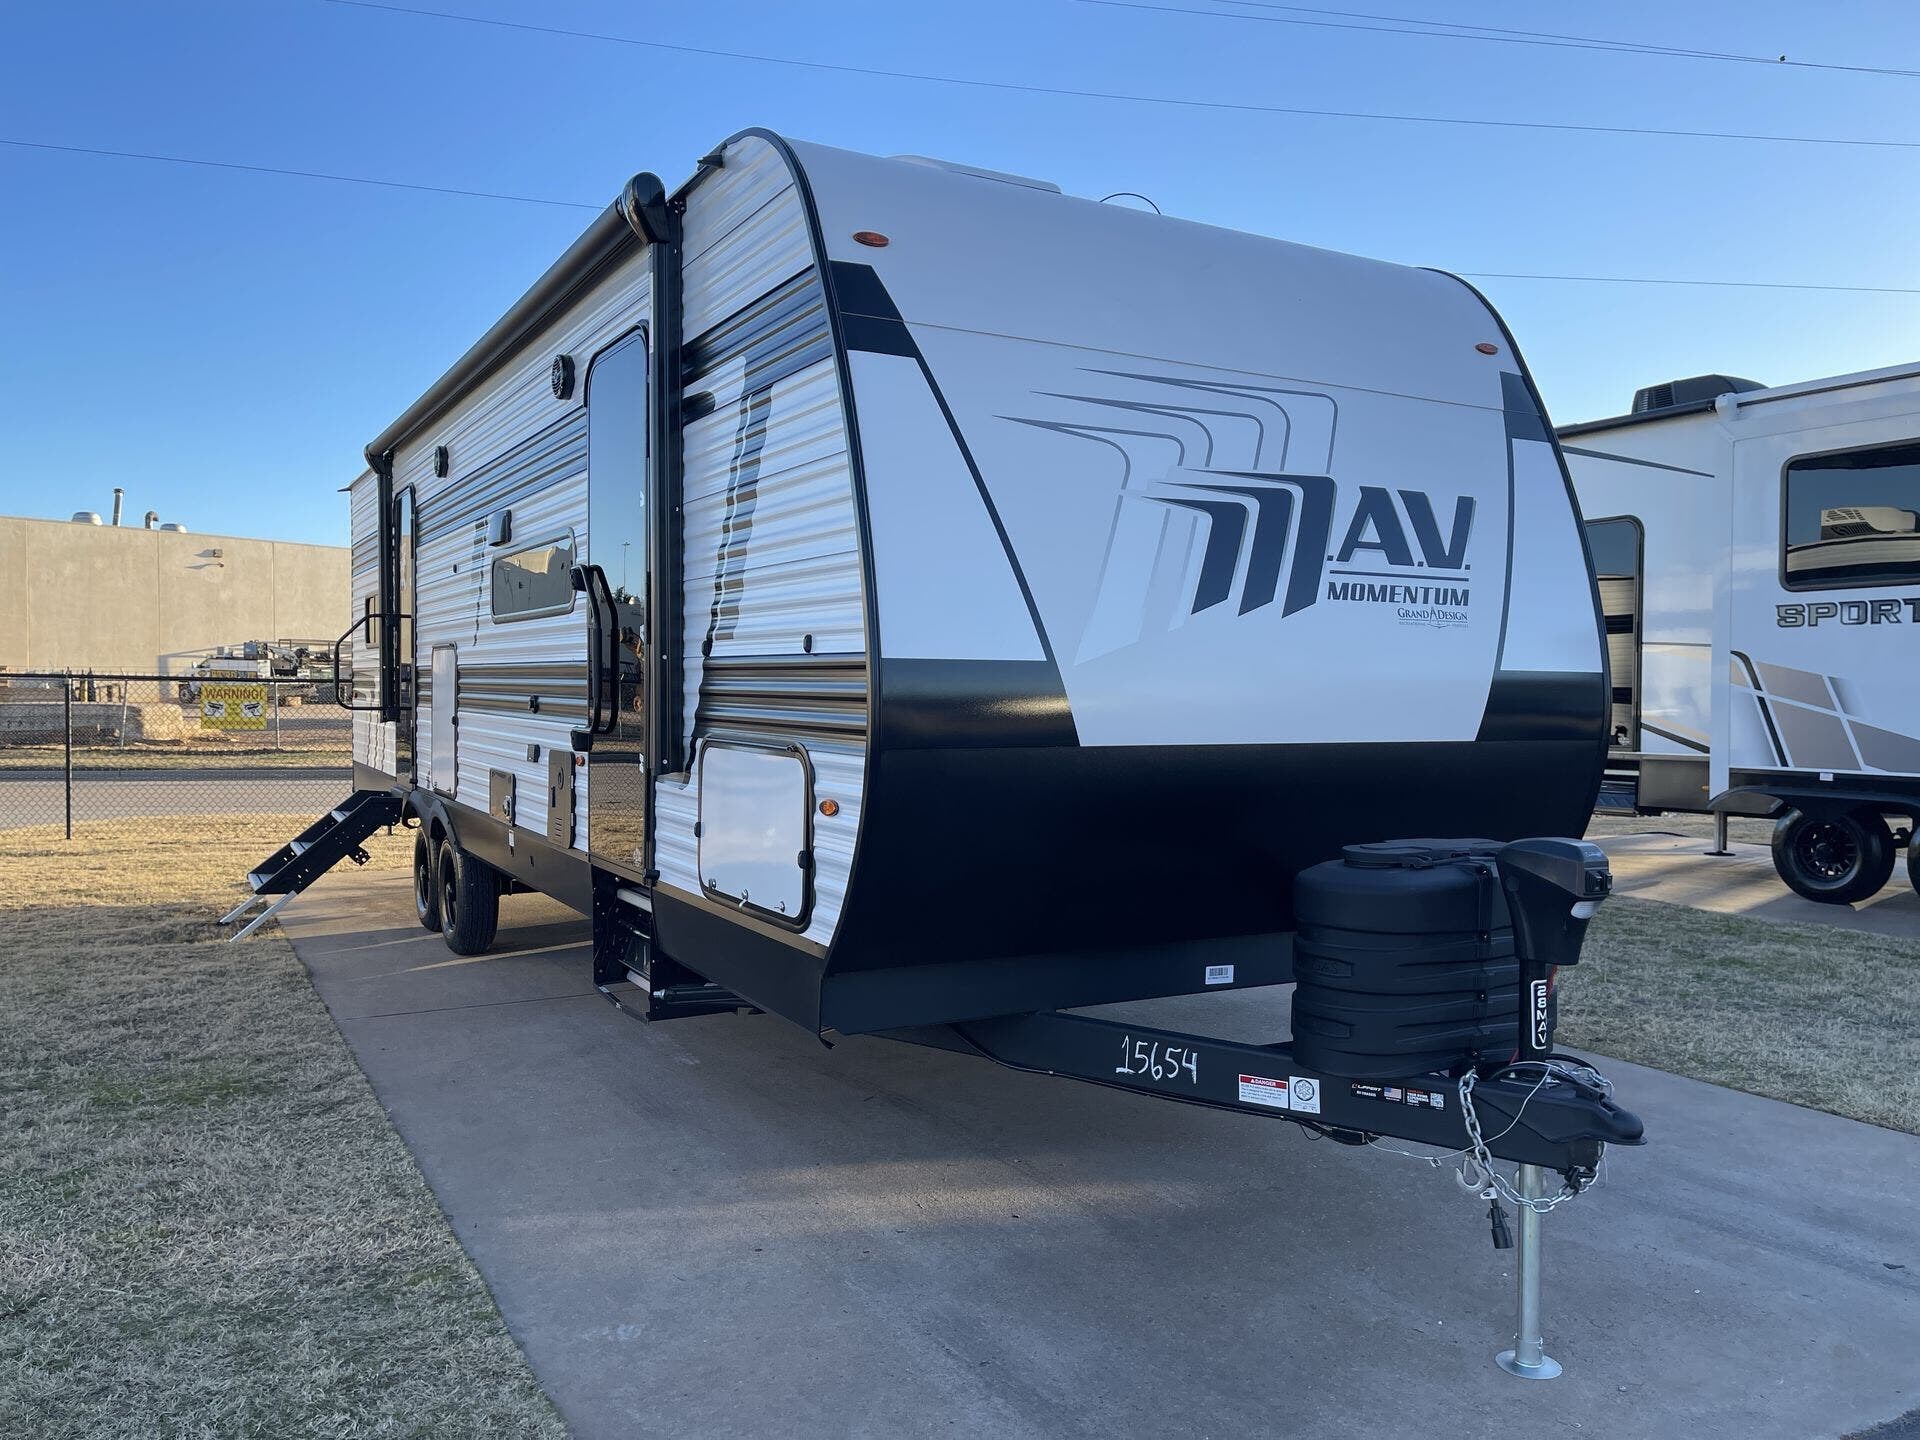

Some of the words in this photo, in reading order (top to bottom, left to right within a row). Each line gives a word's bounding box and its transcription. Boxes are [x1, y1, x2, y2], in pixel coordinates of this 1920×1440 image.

[1326, 581, 1470, 607] MOMENTUM
[1396, 607, 1430, 619] GRAND
[1437, 609, 1468, 621] DESIGN
[205, 688, 263, 700] WARNING!
[1115, 1035, 1198, 1085] 15654
[1254, 1078, 1277, 1087] DANGER
